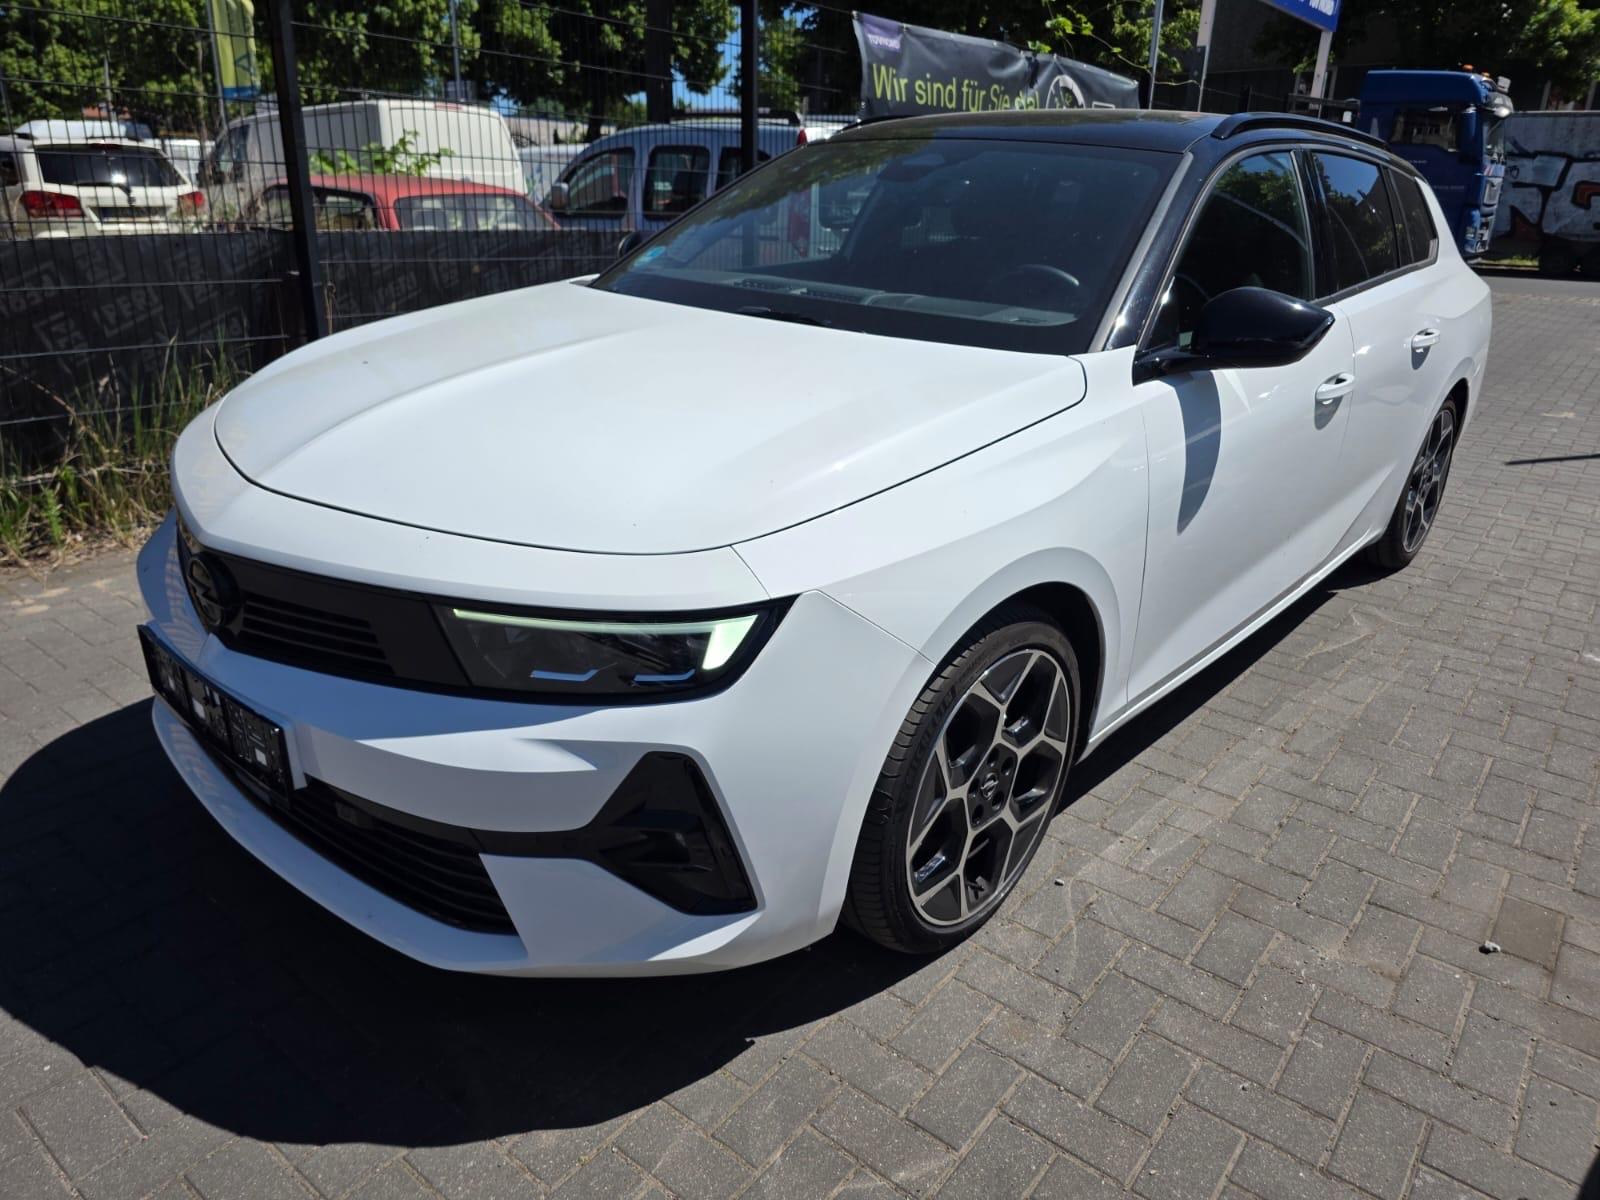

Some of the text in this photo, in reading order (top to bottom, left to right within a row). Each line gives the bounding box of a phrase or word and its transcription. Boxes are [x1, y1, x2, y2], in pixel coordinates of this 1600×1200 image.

[872, 63, 908, 103] Wir
[915, 73, 956, 109] sind
[961, 79, 986, 112] für
[989, 84, 1010, 111] Sie
